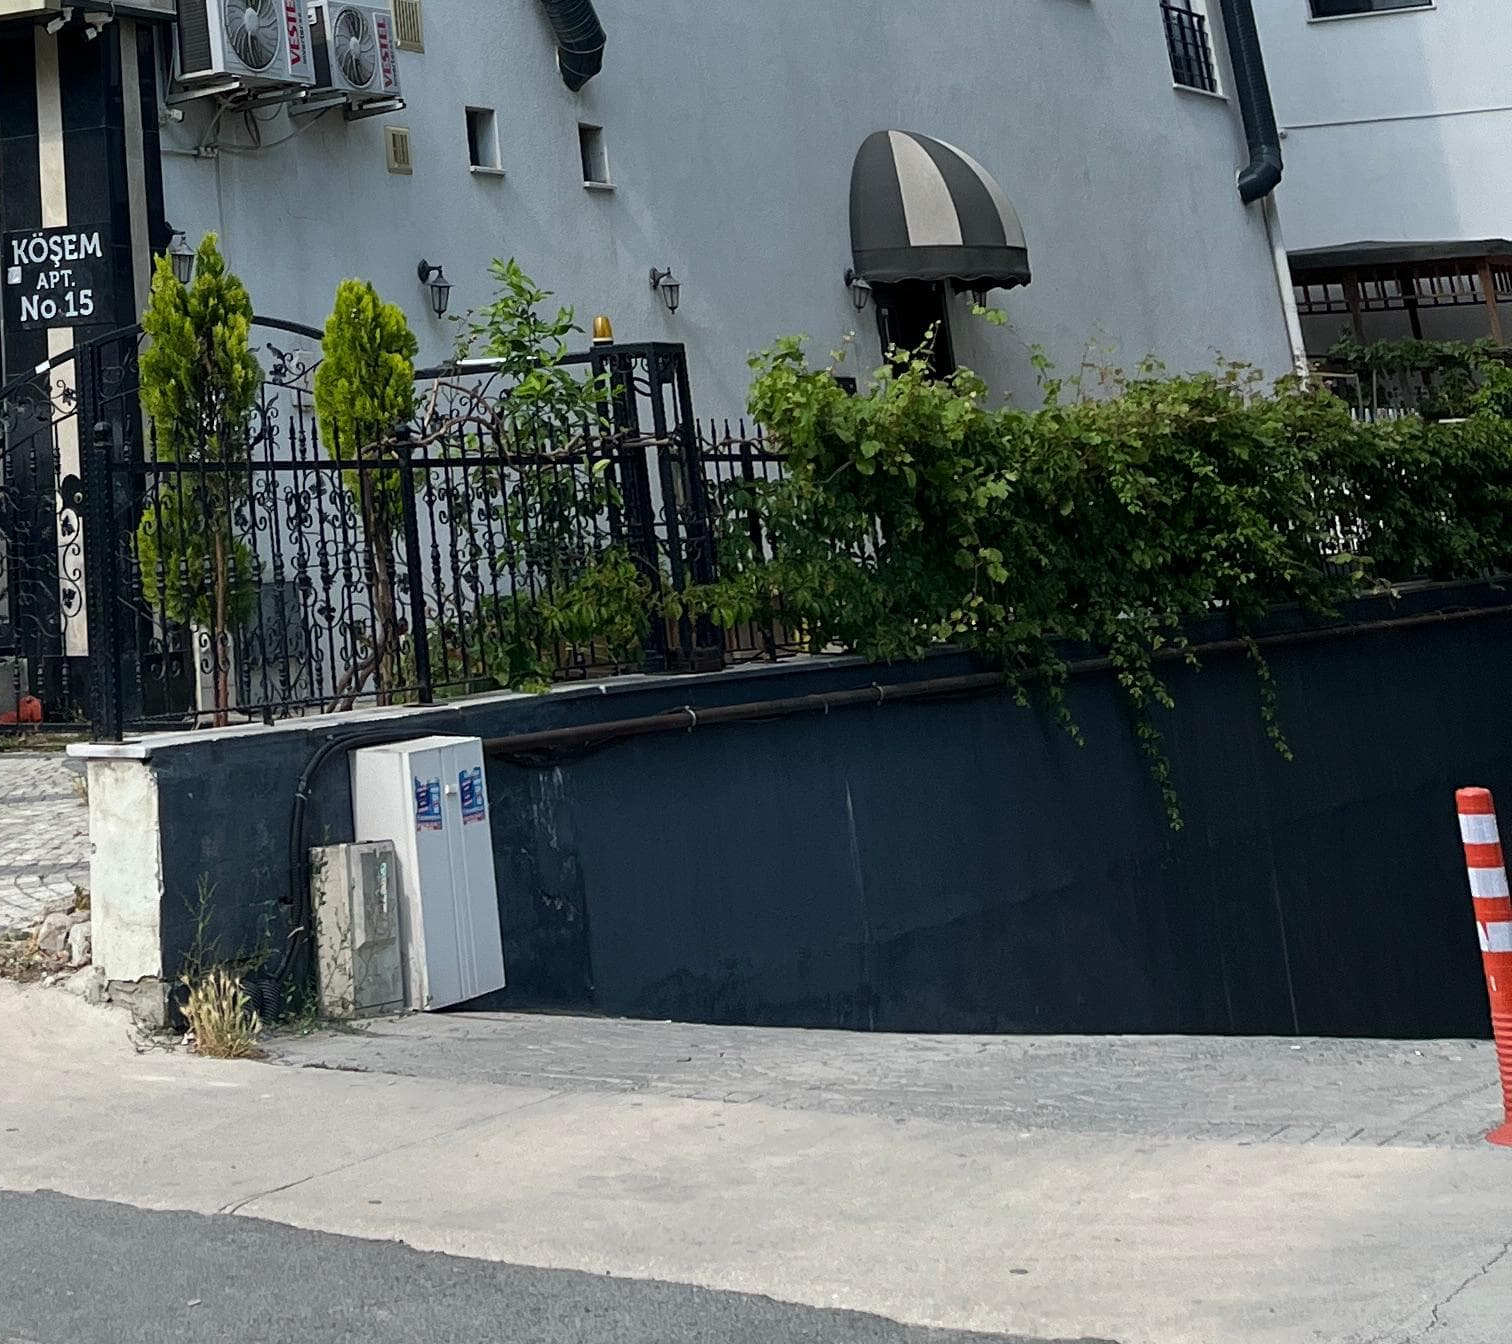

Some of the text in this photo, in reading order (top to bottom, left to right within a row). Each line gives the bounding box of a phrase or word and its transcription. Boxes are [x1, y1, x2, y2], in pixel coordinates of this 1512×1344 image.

[377, 17, 393, 87] VESTEL
[11, 232, 103, 268] KÖŞEM
[36, 269, 76, 290] APT.
